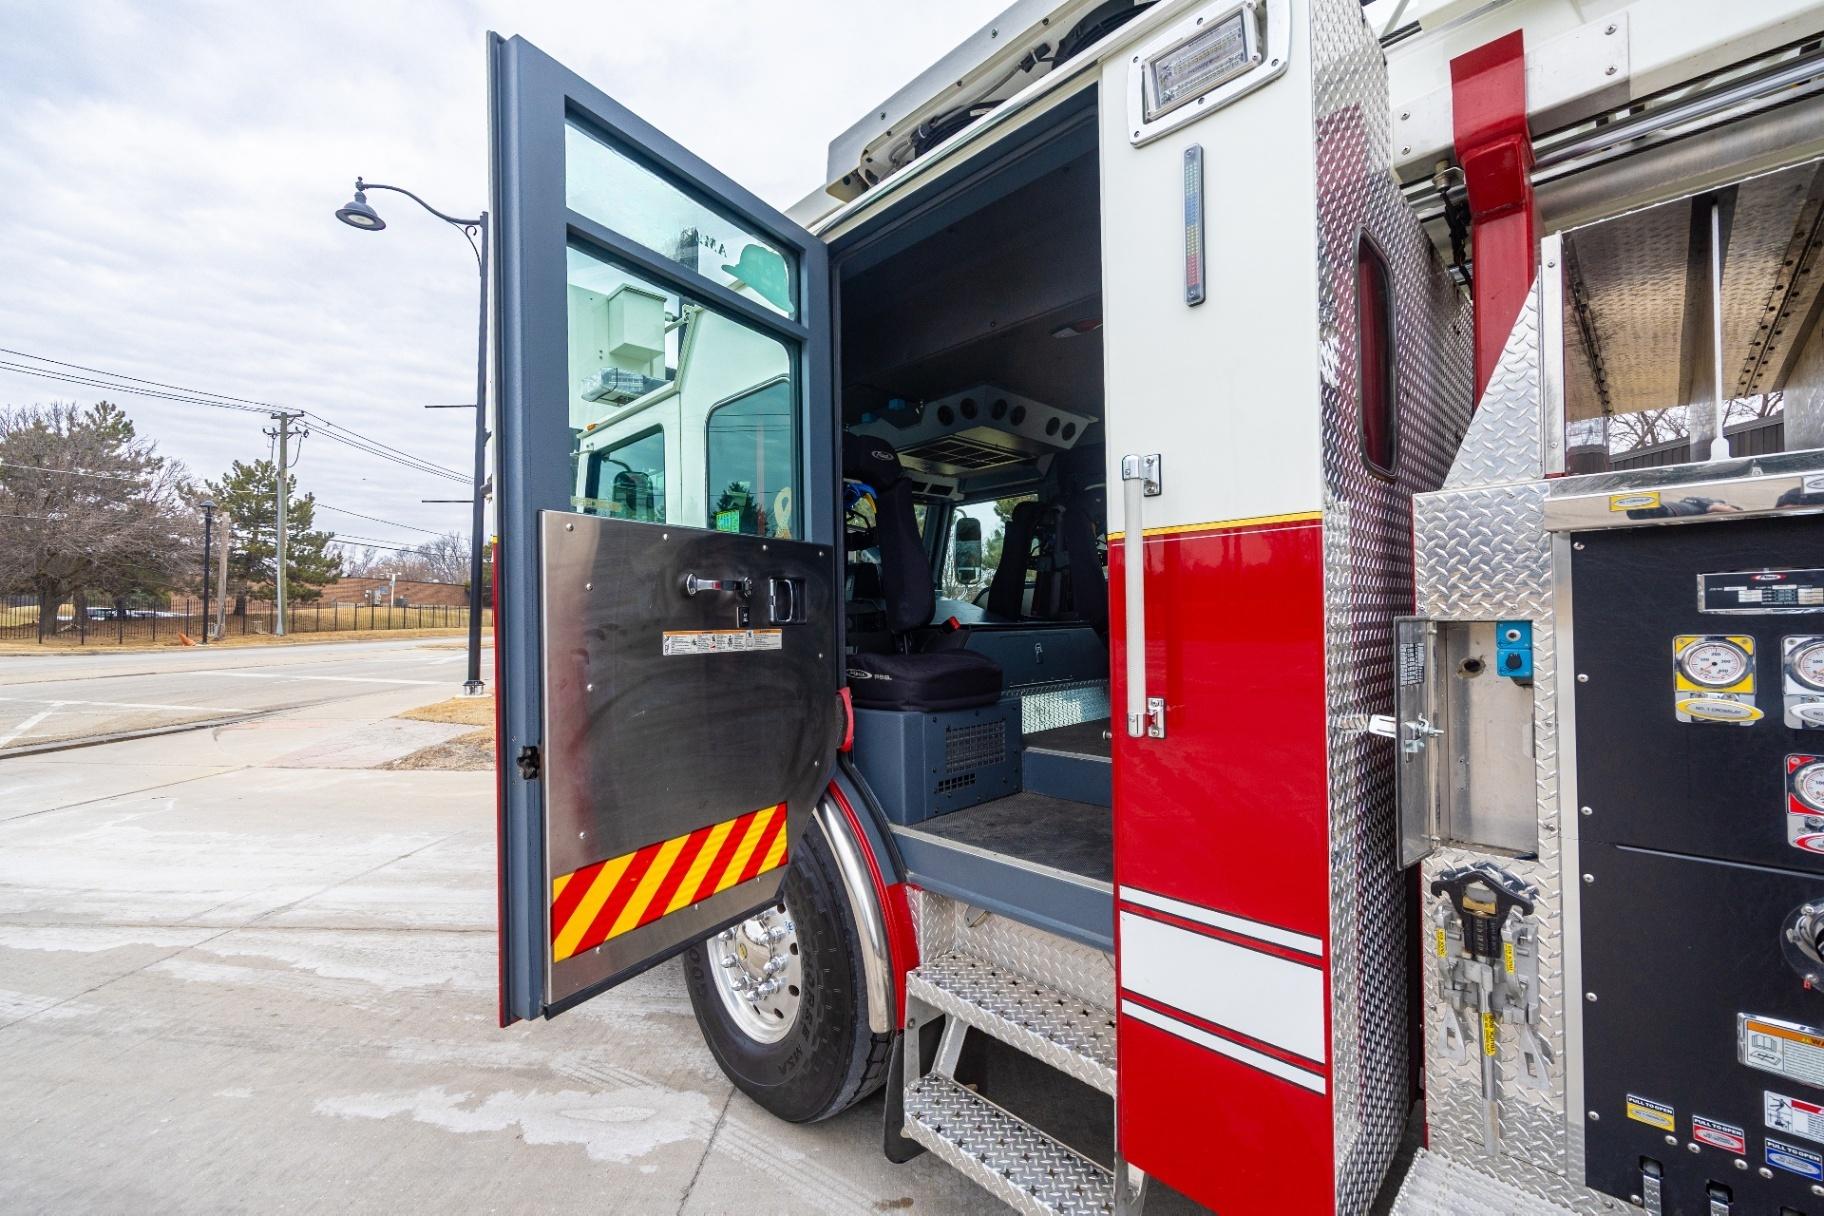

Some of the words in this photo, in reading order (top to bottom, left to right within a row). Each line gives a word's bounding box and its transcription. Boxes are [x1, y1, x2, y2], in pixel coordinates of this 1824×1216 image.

[1629, 1097, 1645, 1106] PULL
[1655, 1105, 1673, 1114] OPEN
[1694, 1118, 1711, 1127] PULL
[1722, 1127, 1742, 1136] OPEN
[1767, 1141, 1786, 1151] PULL
[1798, 1151, 1820, 1162] OPEN
